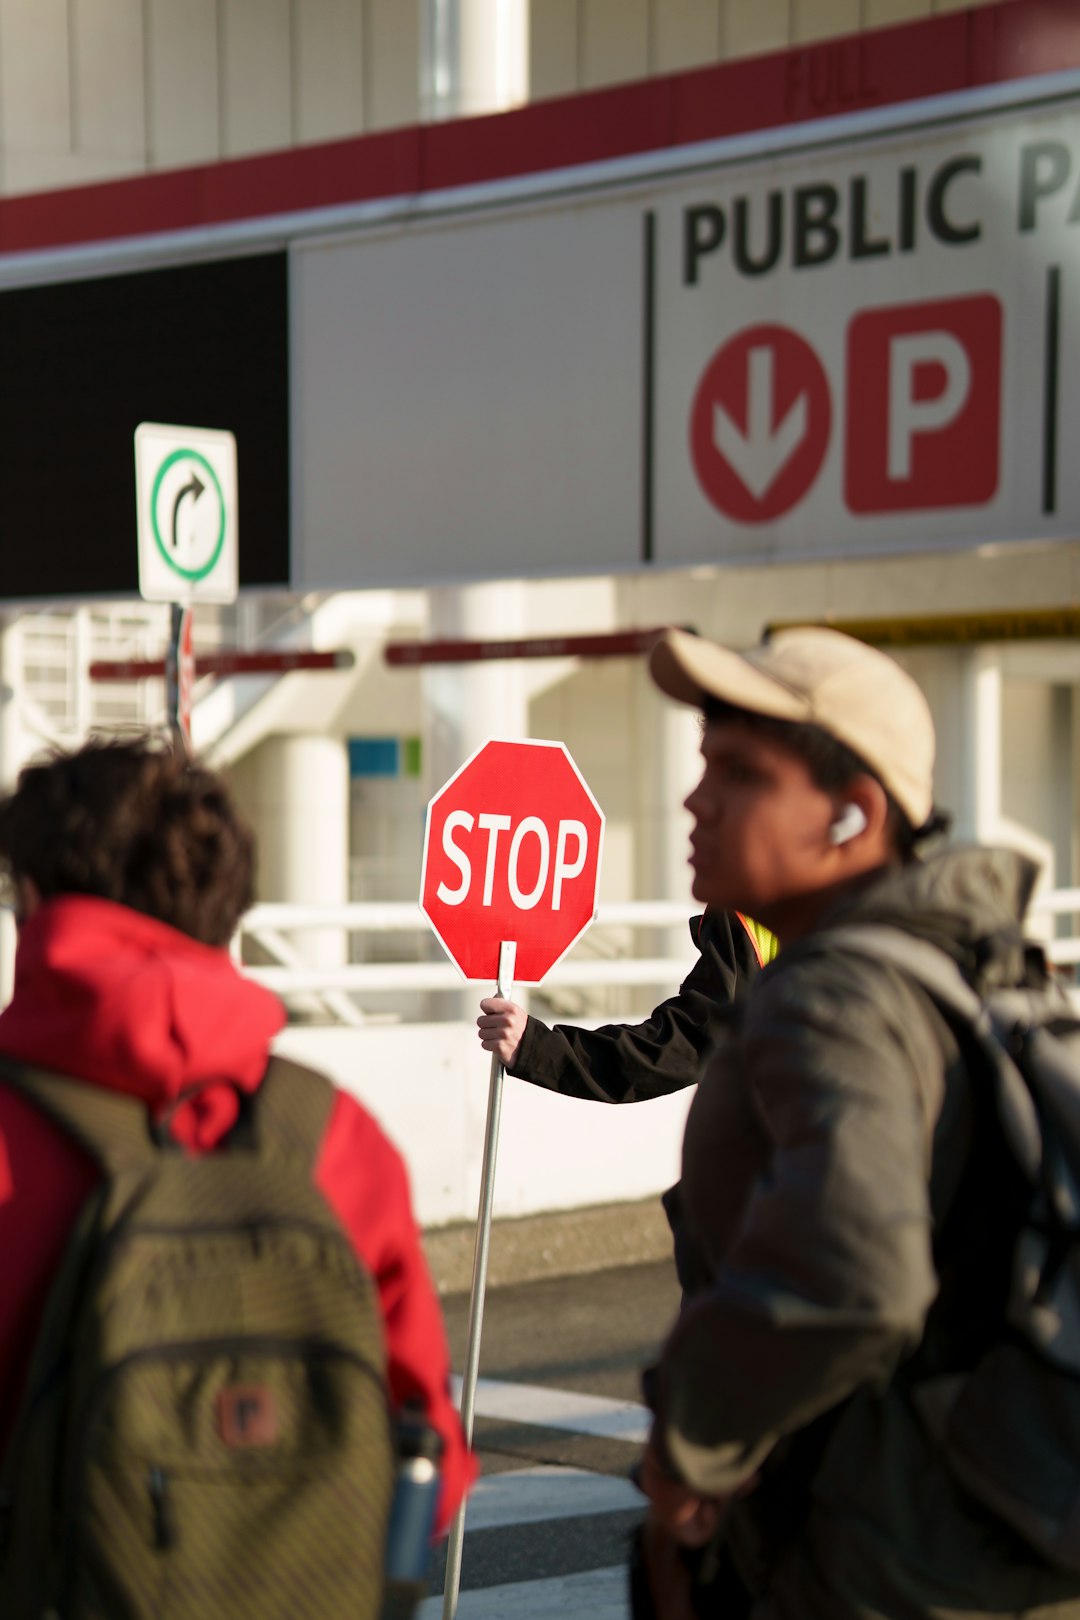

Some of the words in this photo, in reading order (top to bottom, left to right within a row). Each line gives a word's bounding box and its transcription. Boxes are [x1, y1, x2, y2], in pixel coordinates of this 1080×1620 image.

[785, 44, 880, 115] FULL
[684, 154, 983, 286] PUBLIC
[888, 331, 972, 480] P
[436, 810, 588, 911] STOP
